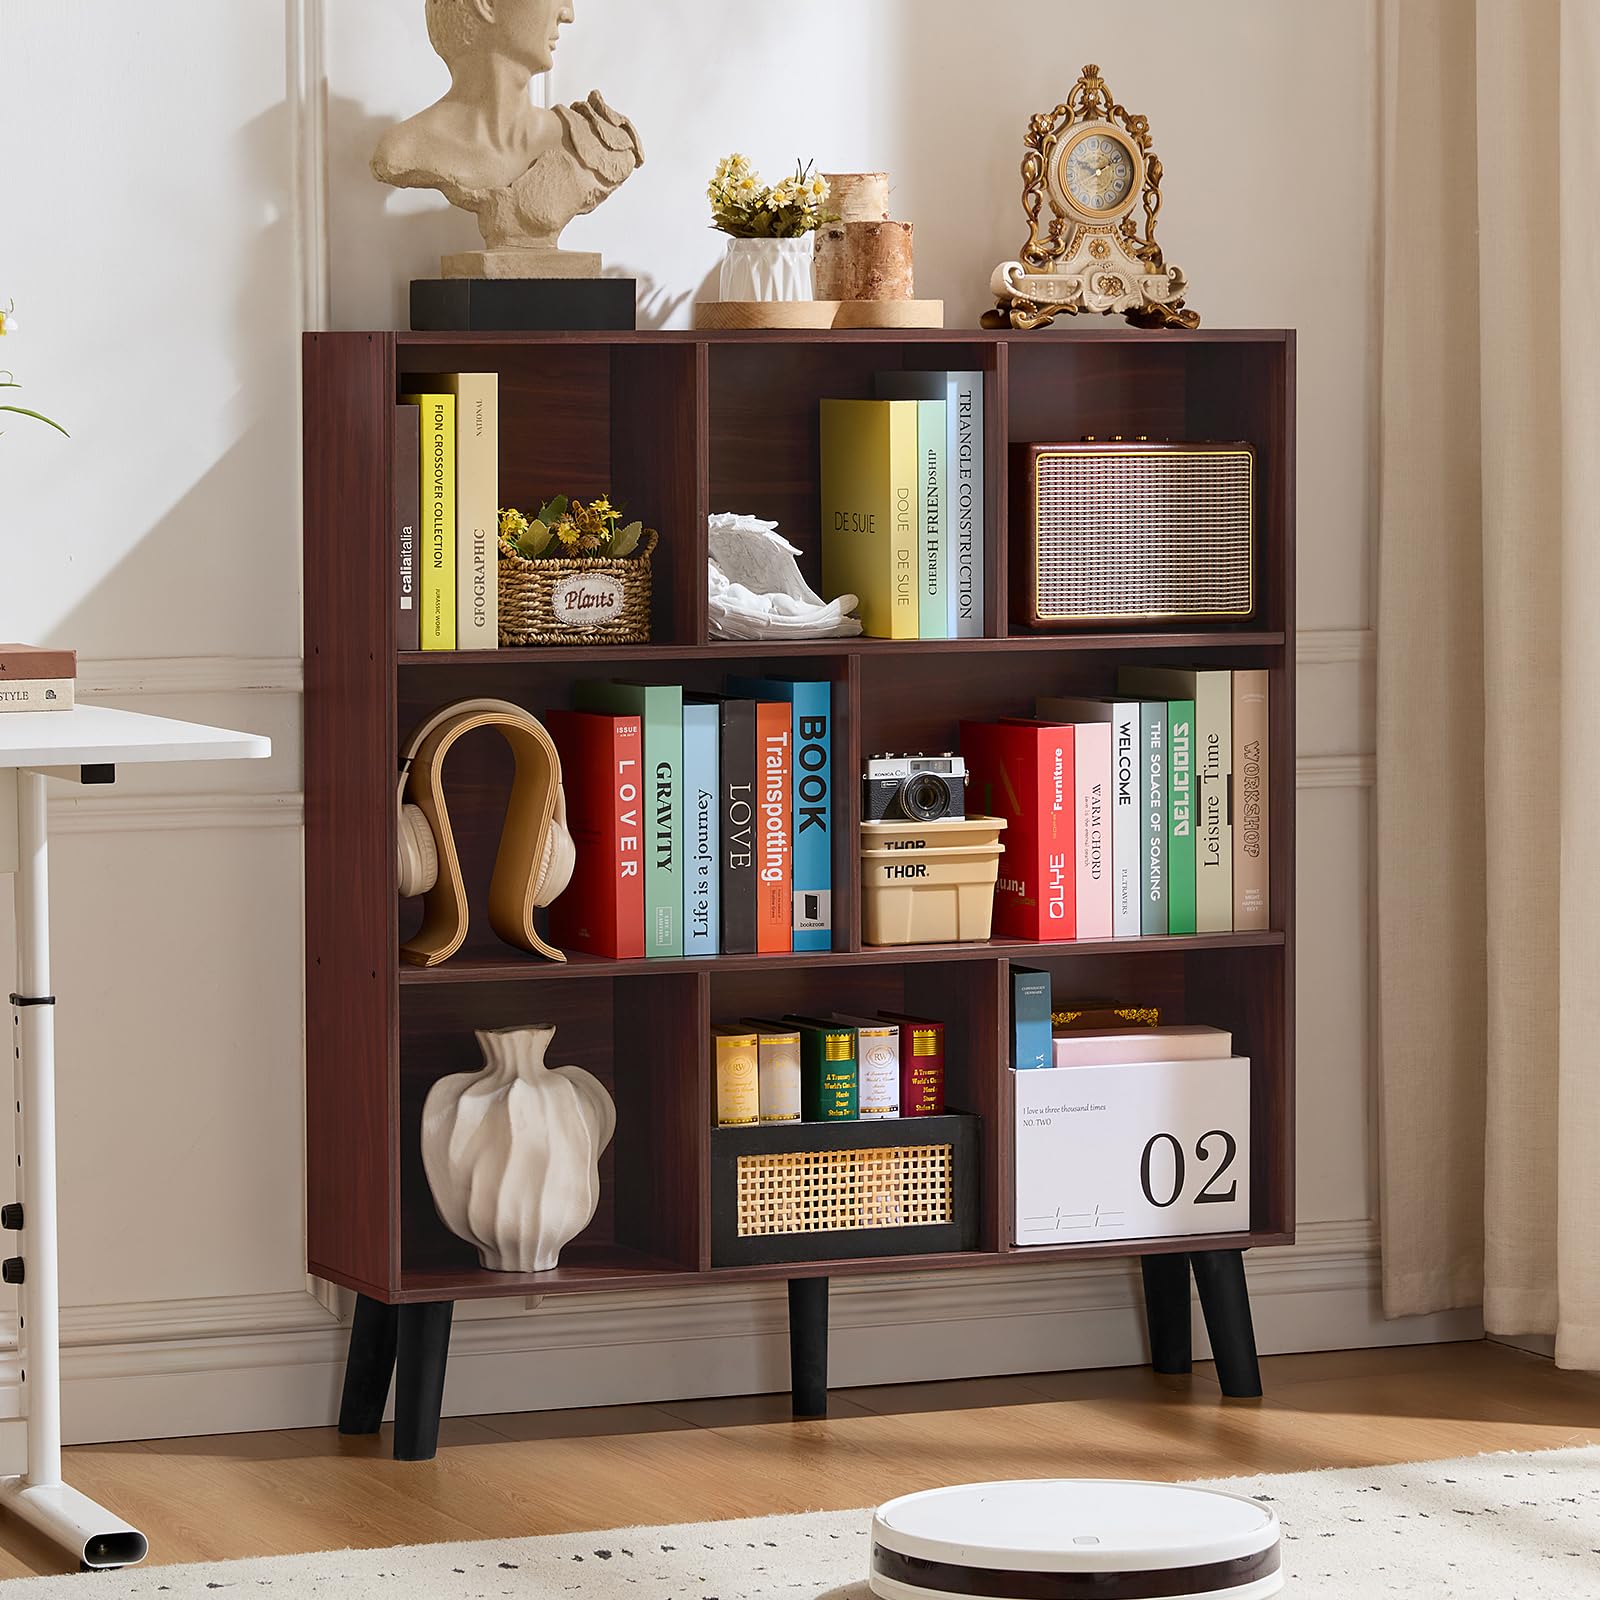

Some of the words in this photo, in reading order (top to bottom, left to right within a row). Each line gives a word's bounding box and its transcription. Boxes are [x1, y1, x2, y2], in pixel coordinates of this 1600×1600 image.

[434, 404, 444, 431] FION
[960, 390, 972, 479] TRIANGLE
[434, 434, 444, 498] CROSSOVER
[927, 449, 938, 534] FRIENDSHIP
[434, 501, 443, 568] COLLECTION
[834, 511, 849, 531] DE
[852, 512, 876, 534] SUIE
[897, 488, 909, 532] DOUE
[897, 550, 909, 569] DE
[928, 540, 938, 596] CHERISH
[960, 483, 972, 619] CONSTRUCTION
[564, 587, 615, 610] Plants
[897, 574, 910, 606] SUIE
[1150, 722, 1160, 748] THE
[1204, 732, 1220, 784] Time
[799, 716, 826, 834] BOOK
[1054, 748, 1062, 811] Furniture
[1119, 722, 1130, 806] WELCOME
[1150, 756, 1160, 808] SOLACE
[1174, 722, 1190, 836] DELICIOUS
[619, 760, 638, 878] LOVER
[656, 762, 672, 873] GRAVITY
[693, 788, 712, 862] journey
[730, 782, 752, 870] LOVE
[1092, 784, 1101, 827] WARM
[1150, 814, 1160, 831] OF
[1244, 740, 1260, 858] WORKSHOP
[1092, 831, 1102, 880] CHORD
[1204, 796, 1220, 868] Leisure
[693, 880, 708, 894] is
[698, 866, 708, 875] a
[996, 878, 1025, 897] Furni
[1150, 838, 1160, 902] SOAKING
[693, 900, 708, 938] Life
[1026, 1106, 1038, 1114] love
[1061, 1104, 1089, 1112] thousand
[1140, 1129, 1238, 1208] 02
